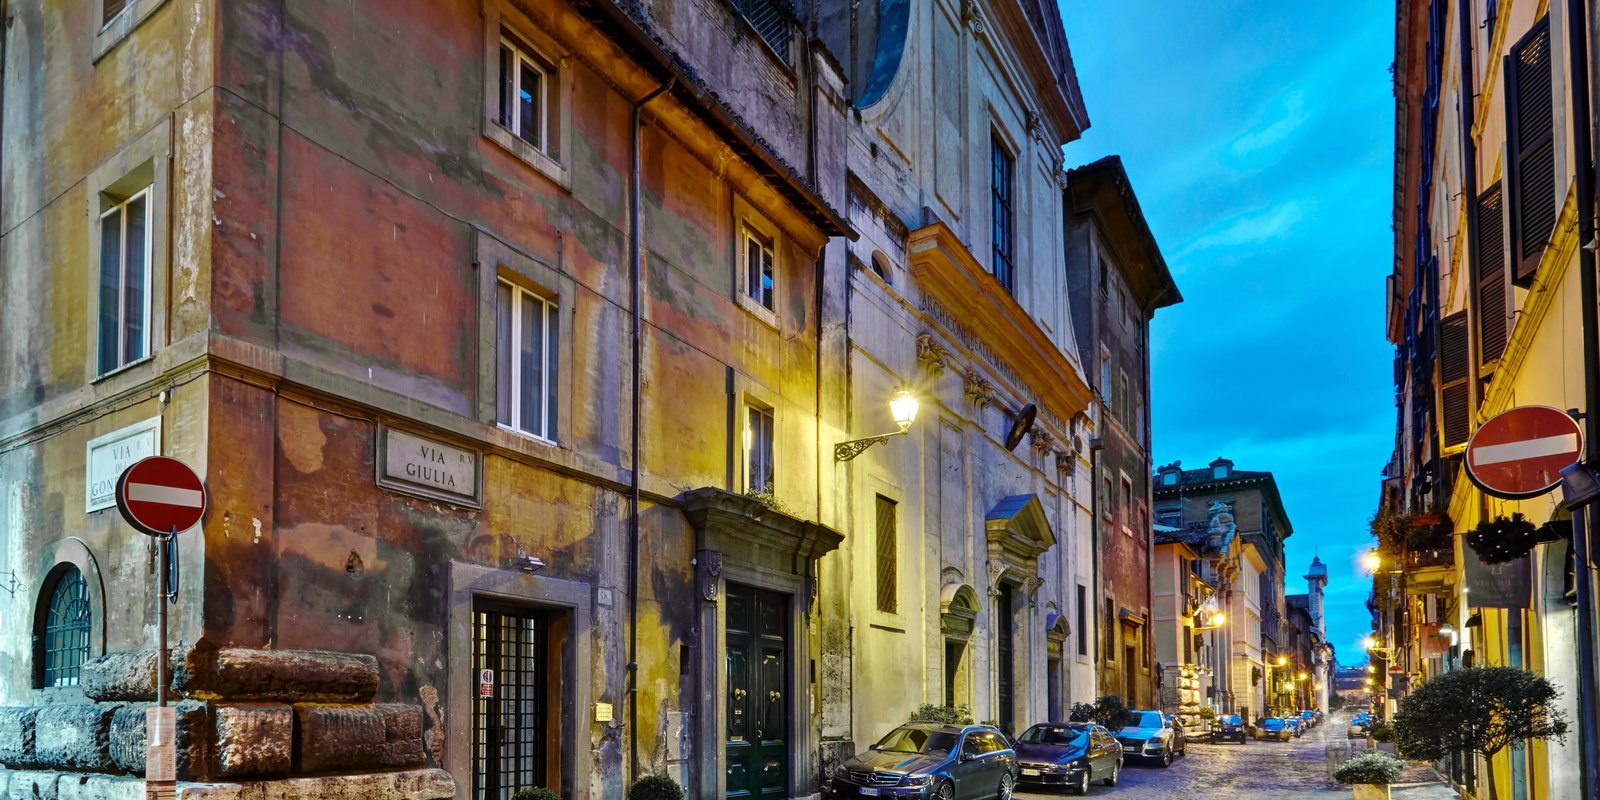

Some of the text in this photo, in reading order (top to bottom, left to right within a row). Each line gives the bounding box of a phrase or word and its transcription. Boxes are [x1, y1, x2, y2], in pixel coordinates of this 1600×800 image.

[113, 446, 131, 460] VIA
[421, 445, 445, 465] VIA
[406, 462, 455, 487] GIULIA
